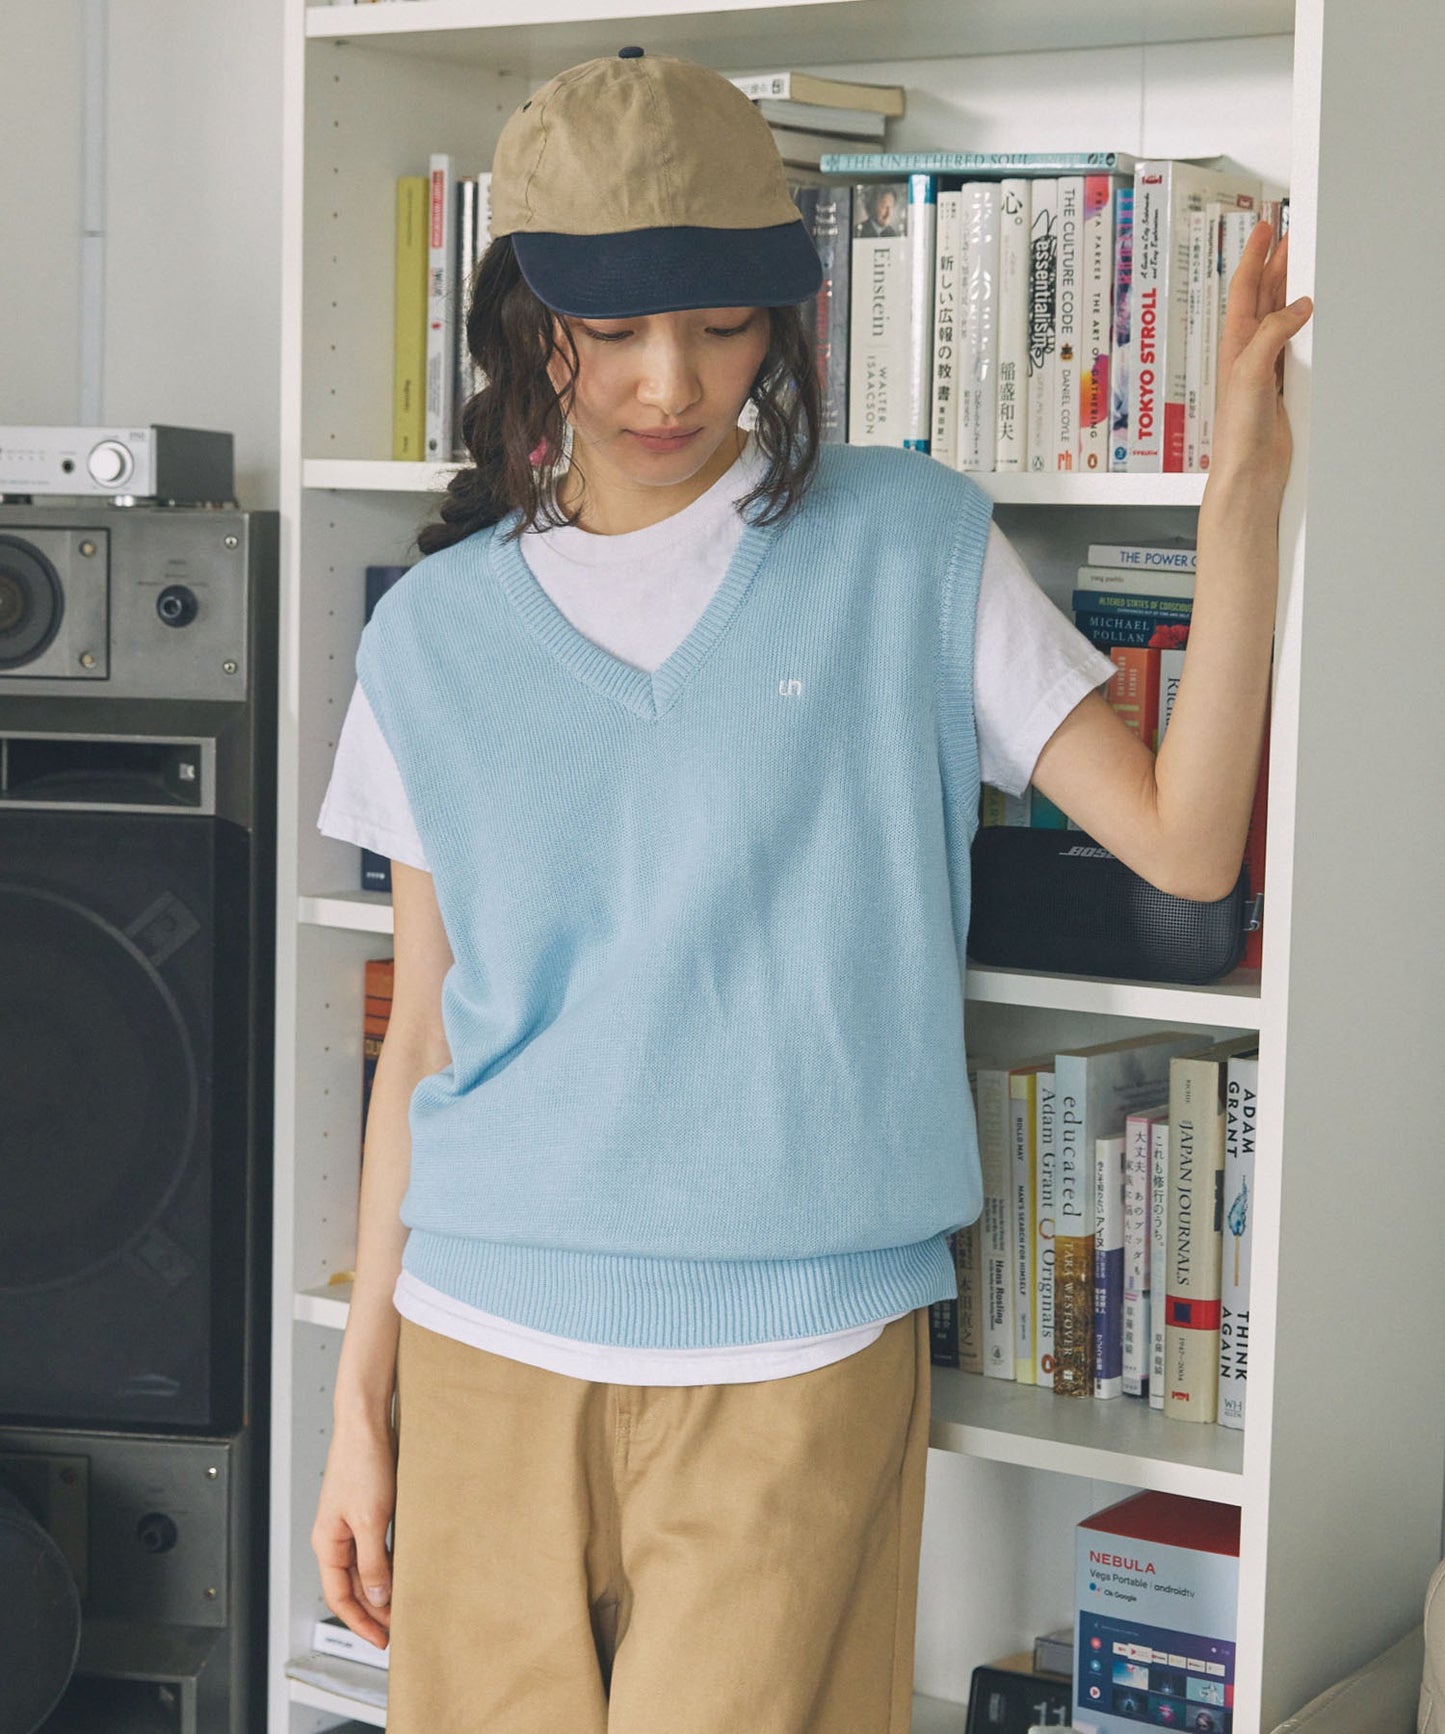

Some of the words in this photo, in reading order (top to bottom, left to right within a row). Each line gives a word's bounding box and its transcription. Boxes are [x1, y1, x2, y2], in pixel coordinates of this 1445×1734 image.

[846, 154, 873, 168] THE
[880, 154, 985, 167] UNTETHERED
[990, 154, 1028, 165] SOUL
[1063, 189, 1075, 217] THE
[1062, 222, 1075, 287] CULTURE
[872, 248, 891, 337] Einstein
[1034, 240, 1049, 351] essentialism
[1061, 292, 1074, 335] CODE
[1093, 294, 1101, 314] THE
[1092, 320, 1100, 342] ART
[1140, 287, 1157, 364] STROLL
[866, 355, 876, 434] ISAACSON
[877, 366, 888, 423] WALTER
[1000, 362, 1016, 441] 稲盛和夫
[1062, 369, 1071, 406] DANIEL
[1090, 370, 1099, 439] GATHERING
[1138, 369, 1155, 441] TOKYO
[1060, 408, 1071, 442] COYLE
[1120, 551, 1142, 564] THE
[1144, 553, 1188, 567] POWER
[1089, 616, 1150, 632] MICHAEL
[1099, 597, 1125, 606] ALTERED
[1126, 599, 1149, 608] STATES
[1150, 601, 1159, 609] OF
[1160, 602, 1192, 612] CONSCIOU
[1093, 630, 1146, 644] POLLAN
[1016, 1117, 1024, 1143] ROLLO
[1042, 1088, 1056, 1144] Adam
[1227, 1081, 1240, 1158] GRANT
[1241, 1088, 1256, 1154] ADAM
[1042, 1152, 1056, 1207] Grant
[1062, 1096, 1083, 1217] educated
[1178, 1124, 1194, 1182] JAPAN
[1018, 1212, 1026, 1243] SEARCH
[1176, 1187, 1193, 1286] JOURNALS
[995, 1260, 1005, 1286] Hans
[1063, 1242, 1074, 1278] TARA
[994, 1287, 1006, 1325] Rosling
[1038, 1249, 1056, 1338] Originals
[1063, 1282, 1074, 1356] WESTOVER
[1220, 1306, 1233, 1379] AGAIN
[1235, 1311, 1250, 1381] THINK
[1089, 1550, 1156, 1575] NEBULA
[1089, 1568, 1111, 1582] Vega
[1112, 1573, 1148, 1589] Portable
[1114, 1591, 1137, 1602] Google
